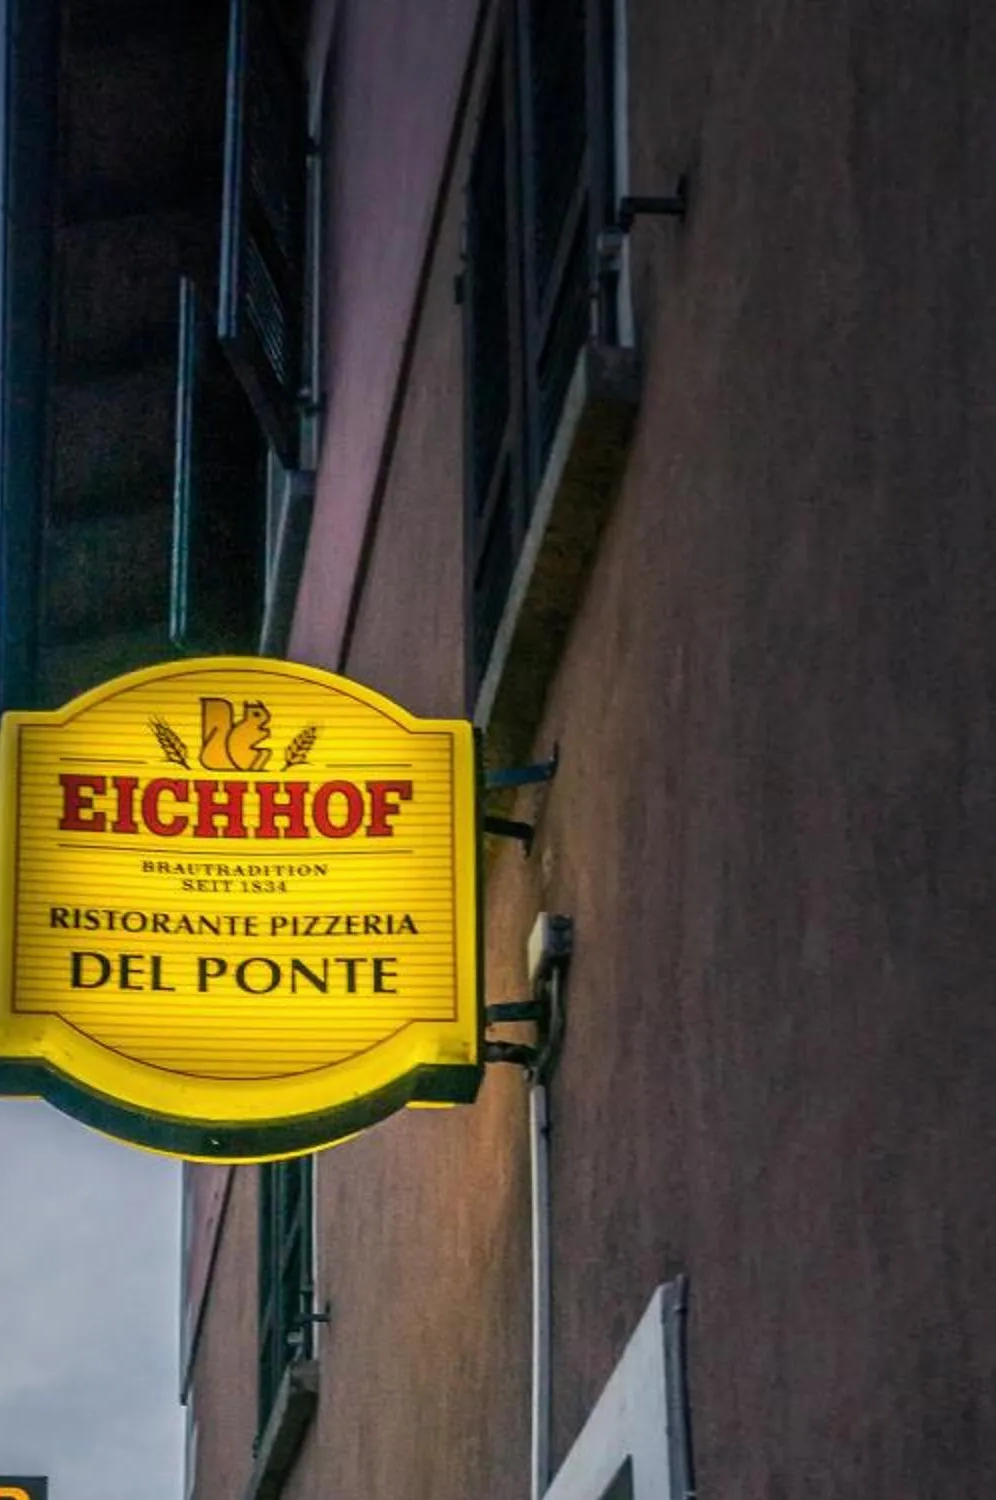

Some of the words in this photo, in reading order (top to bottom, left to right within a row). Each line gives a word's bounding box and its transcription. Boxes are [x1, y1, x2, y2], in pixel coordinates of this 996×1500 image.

[59, 773, 413, 840] EICHHOF
[142, 860, 329, 877] BRAUTRADITION
[182, 879, 233, 893] SEIT
[241, 880, 288, 894] 1834
[49, 906, 259, 937] RISTORANTE
[271, 912, 420, 937] PIZZERIA
[70, 951, 175, 991] DEL
[199, 957, 398, 994] PONTE
